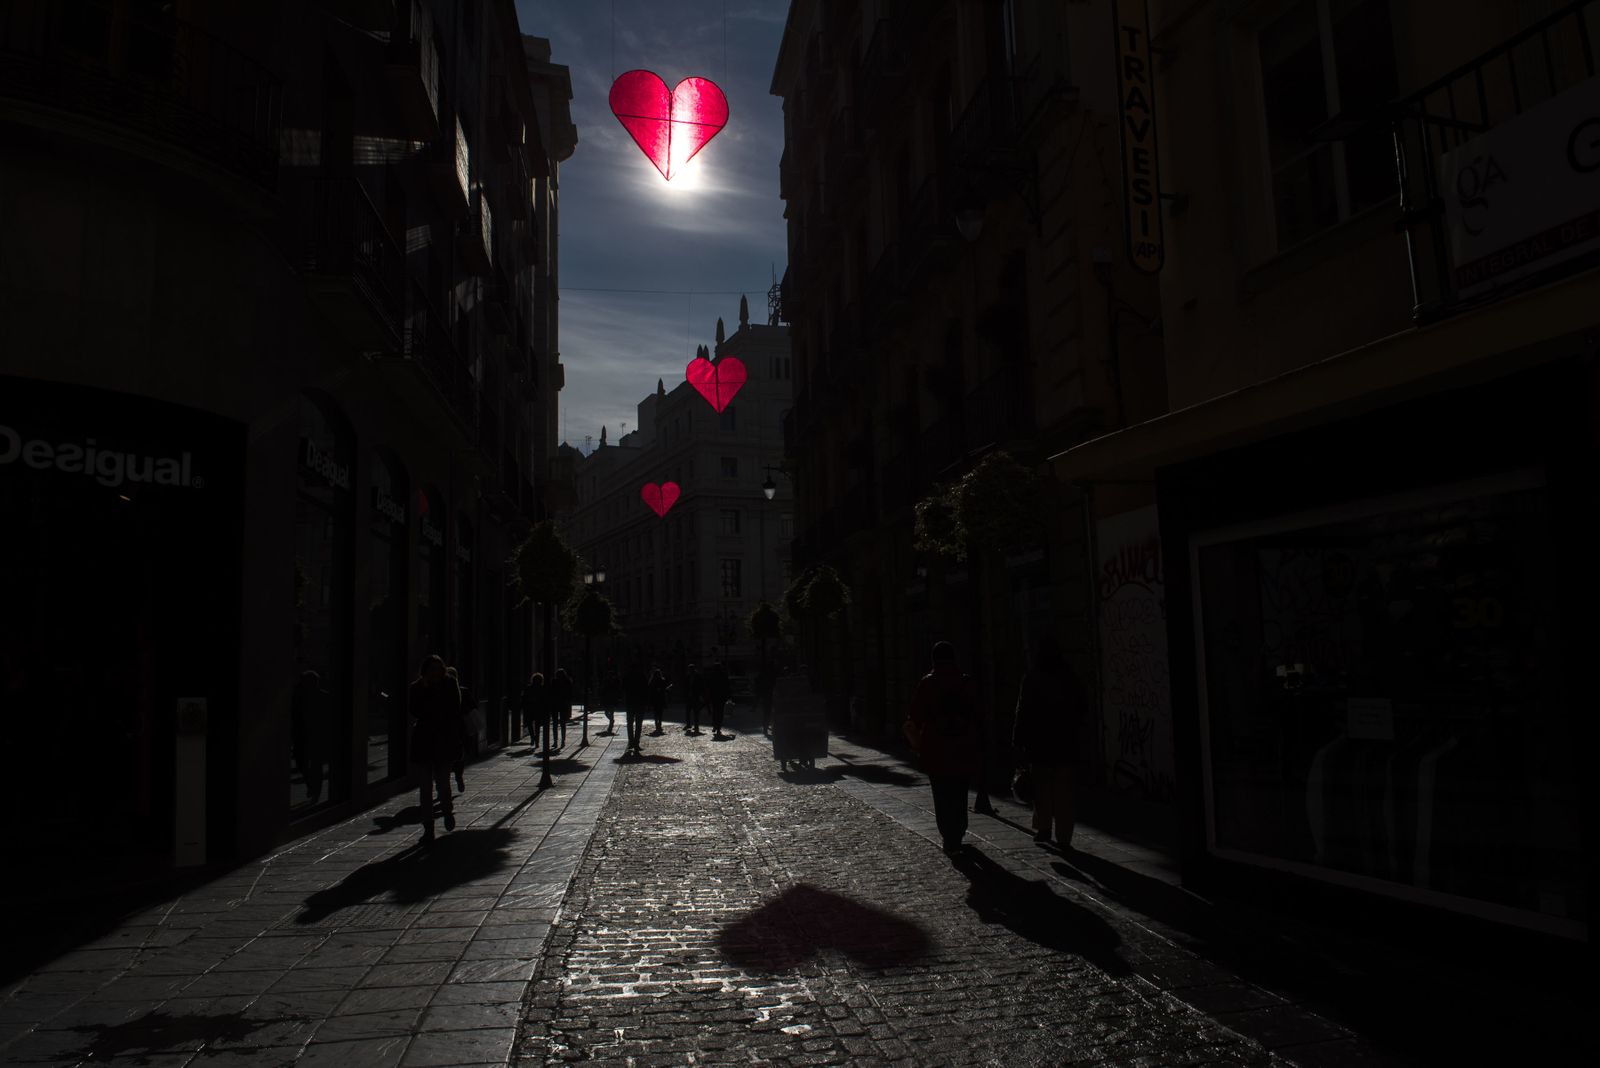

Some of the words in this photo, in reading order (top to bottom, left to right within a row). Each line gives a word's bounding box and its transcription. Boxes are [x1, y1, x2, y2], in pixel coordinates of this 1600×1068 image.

[1122, 25, 1153, 237] TRAVESI
[1457, 233, 1553, 287] INTEGRAL
[1561, 217, 1591, 243] DE
[306, 437, 350, 487] Desigual
